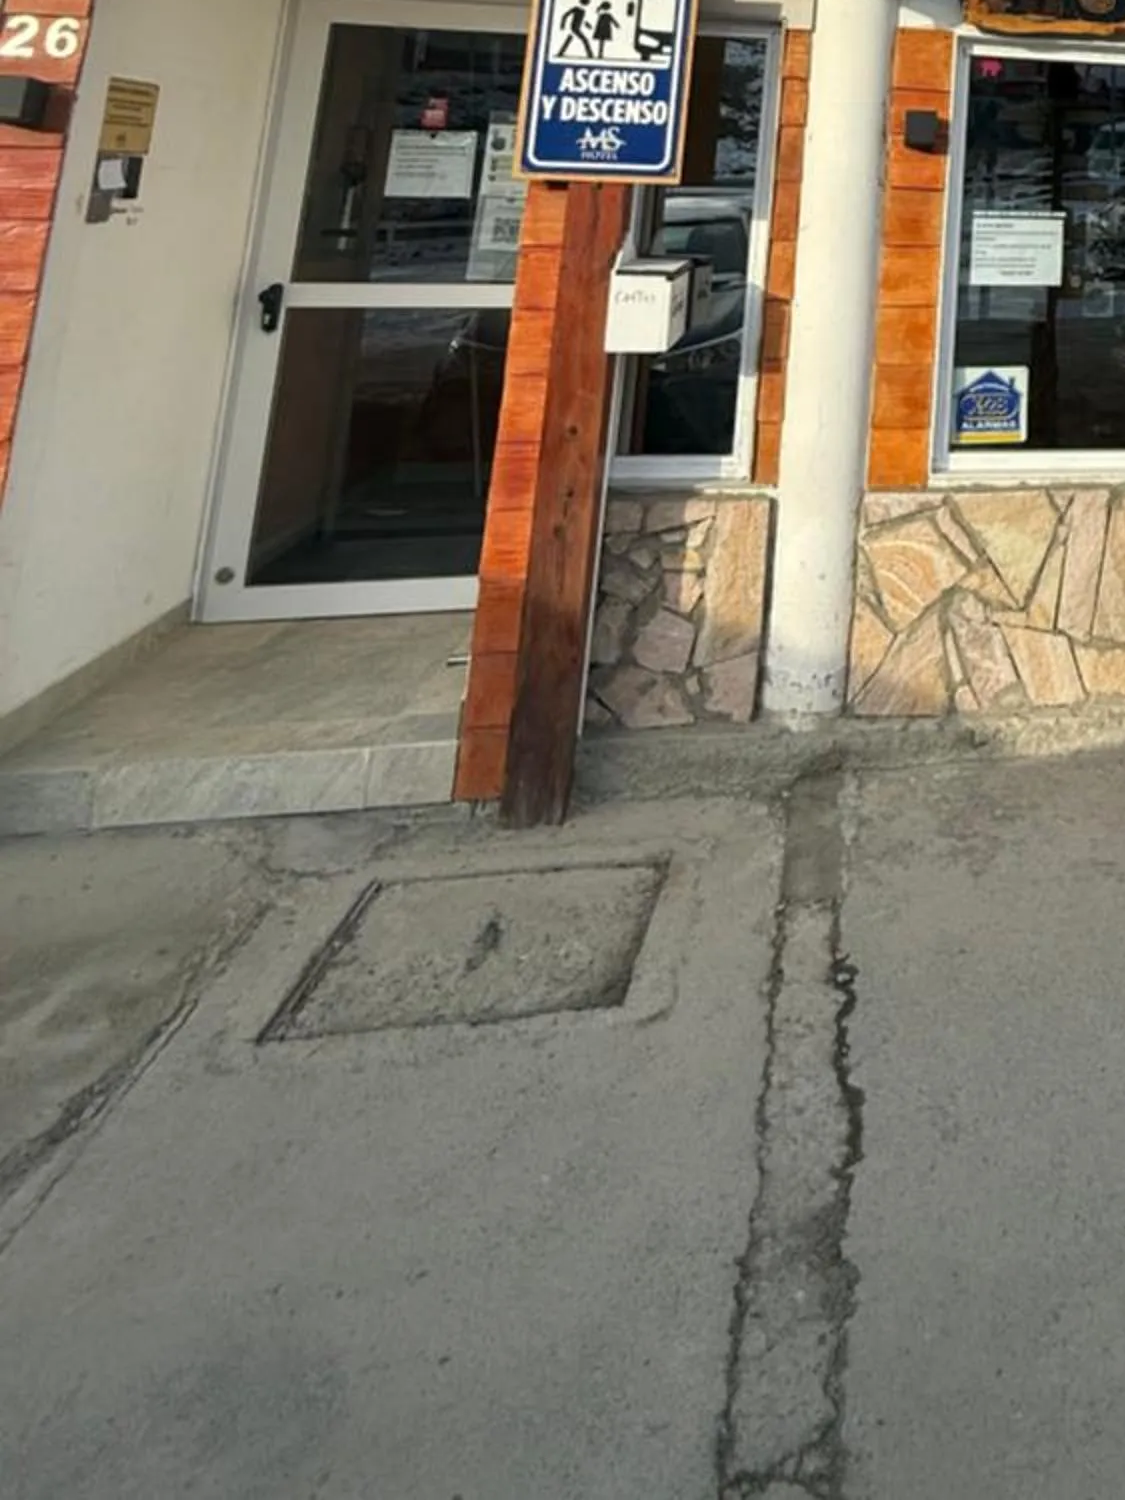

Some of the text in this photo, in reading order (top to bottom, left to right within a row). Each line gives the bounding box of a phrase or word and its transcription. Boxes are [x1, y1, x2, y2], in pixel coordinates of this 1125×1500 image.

[0, 14, 80, 57] 26
[559, 67, 656, 95] ASCENSO
[541, 95, 668, 125] Y DESCENSO
[576, 126, 627, 151] MS
